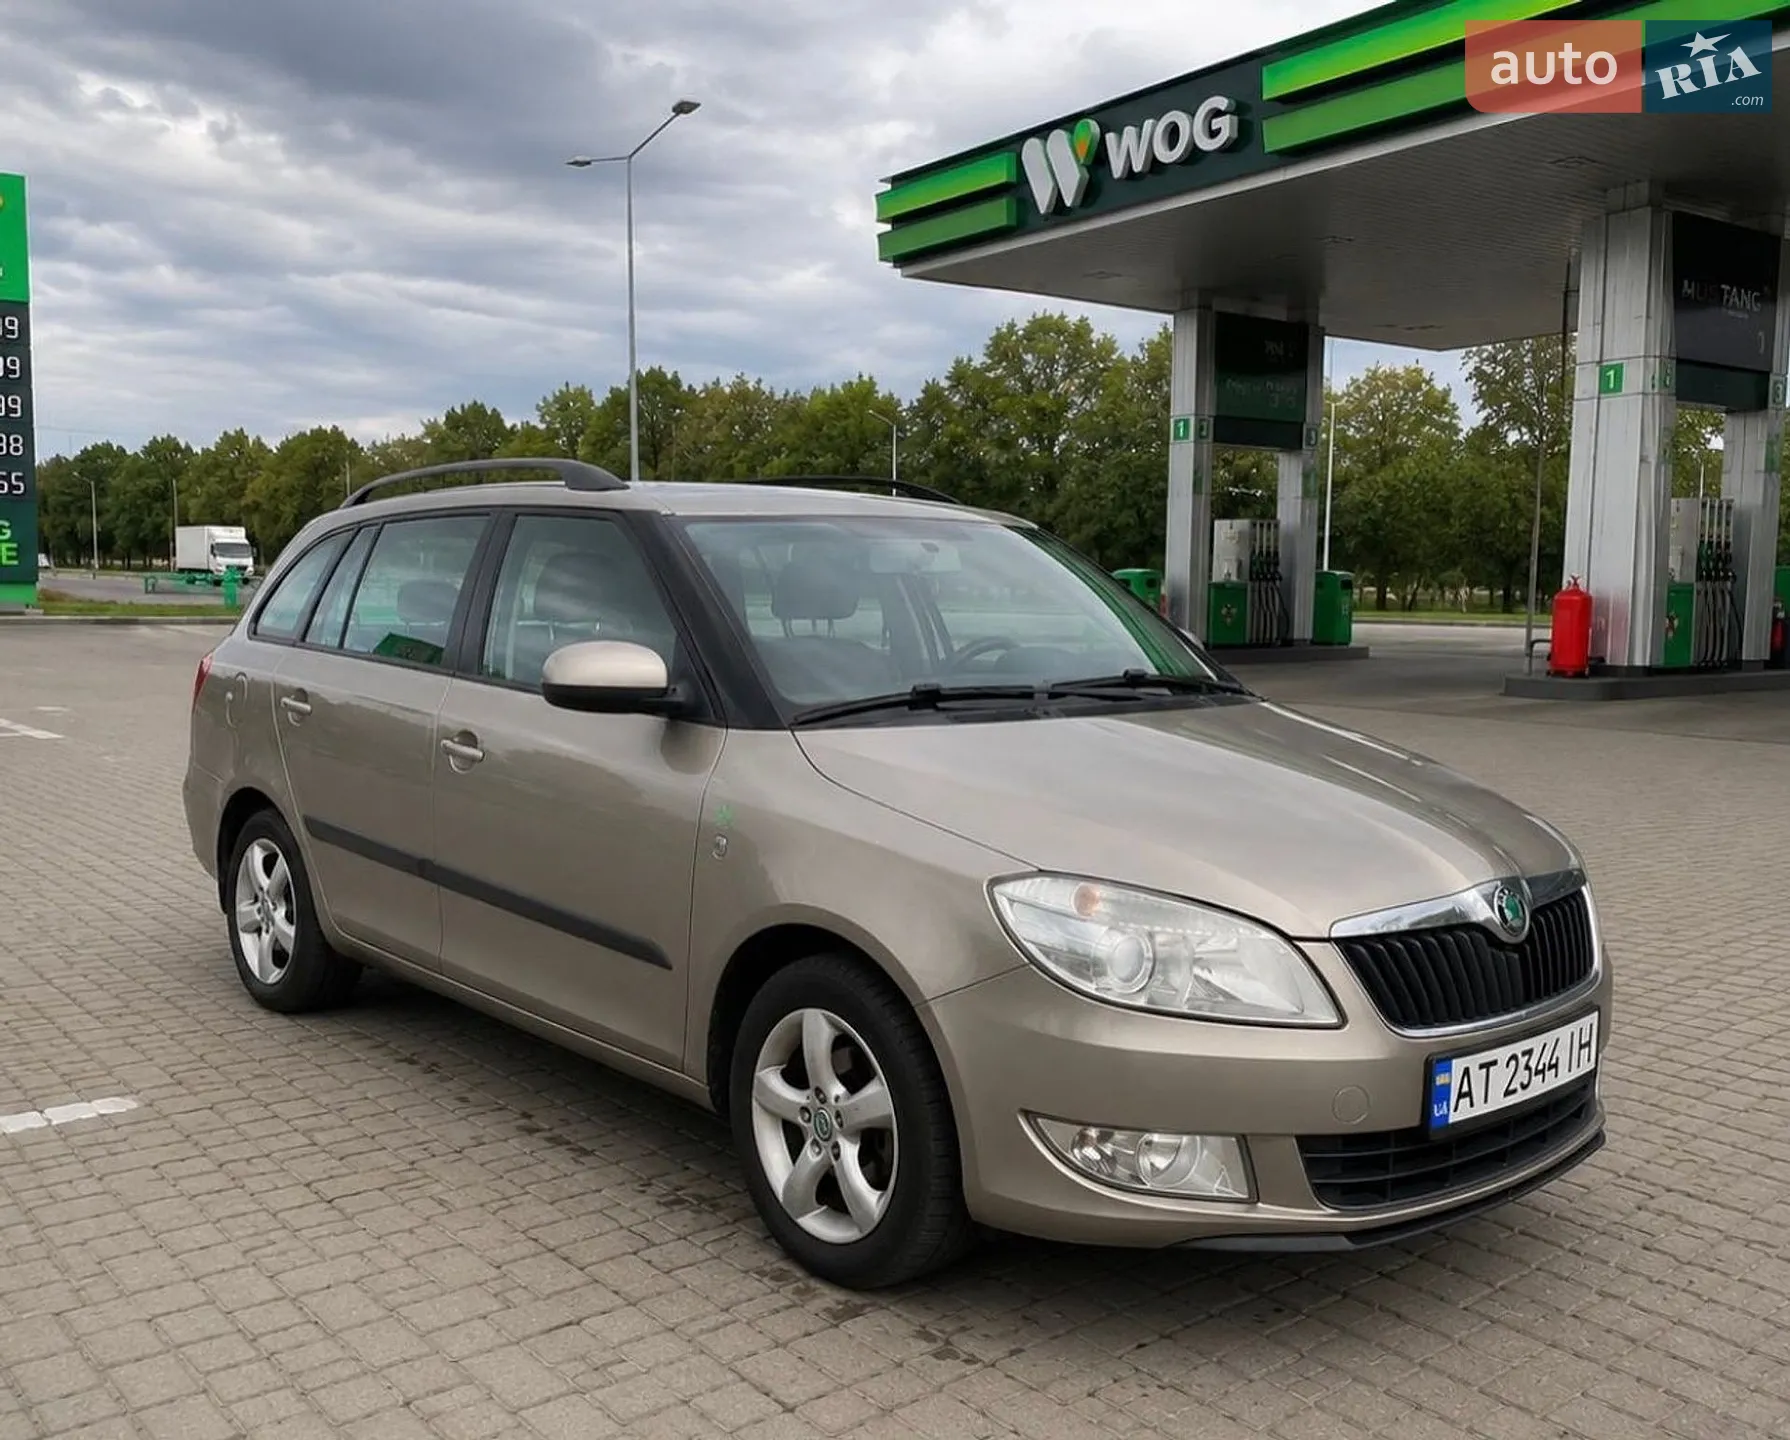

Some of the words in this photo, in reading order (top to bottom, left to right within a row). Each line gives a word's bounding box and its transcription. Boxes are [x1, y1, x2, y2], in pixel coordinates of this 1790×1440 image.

[1105, 95, 1239, 180] WOG
[0, 315, 19, 339] 9
[1605, 370, 1616, 390] 1
[1176, 420, 1185, 438] 1
[1453, 1059, 1499, 1113] AT
[1503, 1037, 1561, 1098] 2344
[1567, 1023, 1594, 1073] IH
